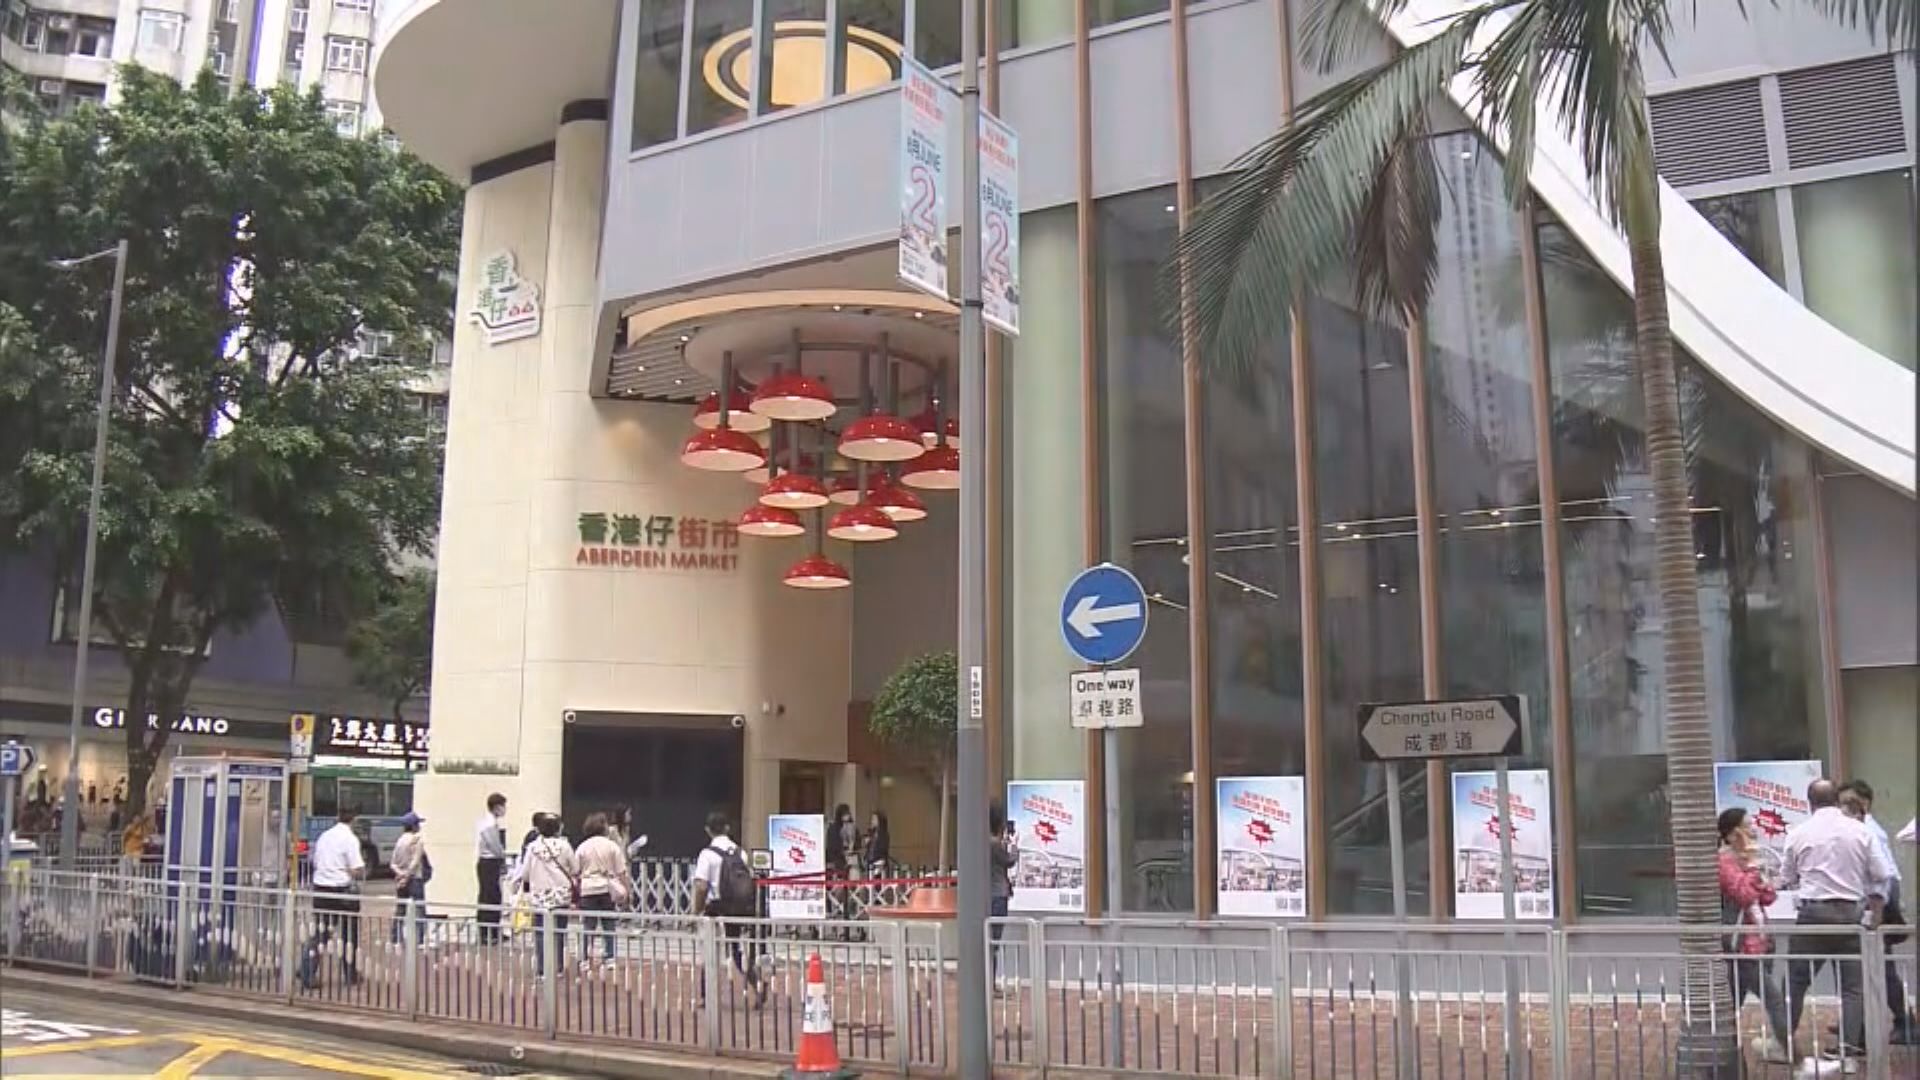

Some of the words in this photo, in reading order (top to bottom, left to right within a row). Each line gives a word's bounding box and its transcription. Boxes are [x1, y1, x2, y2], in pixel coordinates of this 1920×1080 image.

[910, 166, 937, 234] 2
[577, 512, 739, 549] 香港仔街市
[577, 547, 667, 568] ABERDEEN
[671, 552, 738, 570] MARKET
[1077, 680, 1104, 693] One
[1107, 679, 1135, 691] way
[1380, 709, 1447, 727] Chengtu
[1451, 706, 1495, 722] Road
[1405, 731, 1473, 752] 成都道
